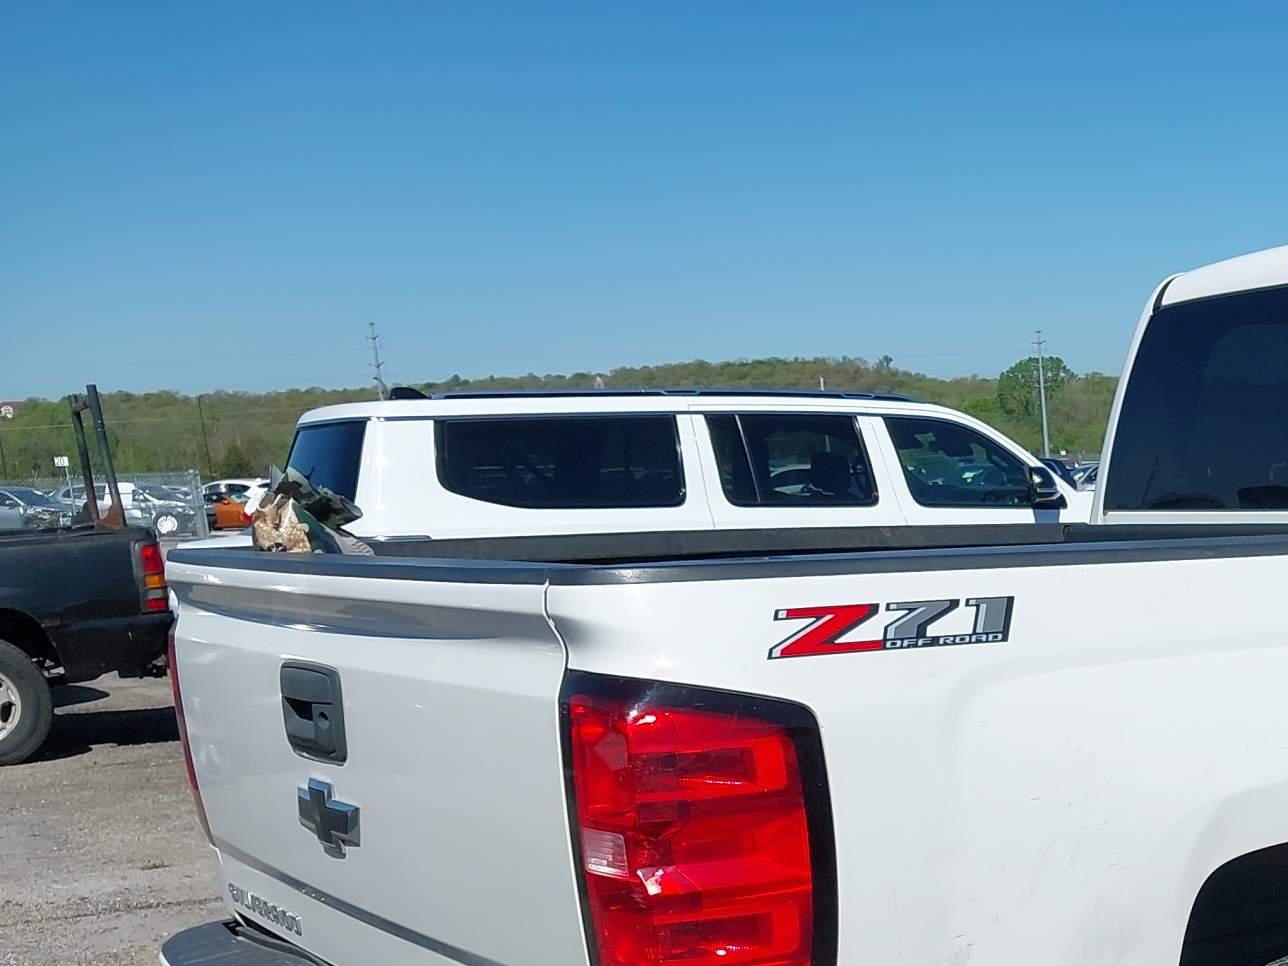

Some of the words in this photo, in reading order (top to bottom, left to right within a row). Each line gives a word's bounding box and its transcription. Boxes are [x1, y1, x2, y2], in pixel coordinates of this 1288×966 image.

[767, 596, 1015, 660] Z71
[885, 637, 933, 649] OFF
[939, 632, 1004, 645] ROAD
